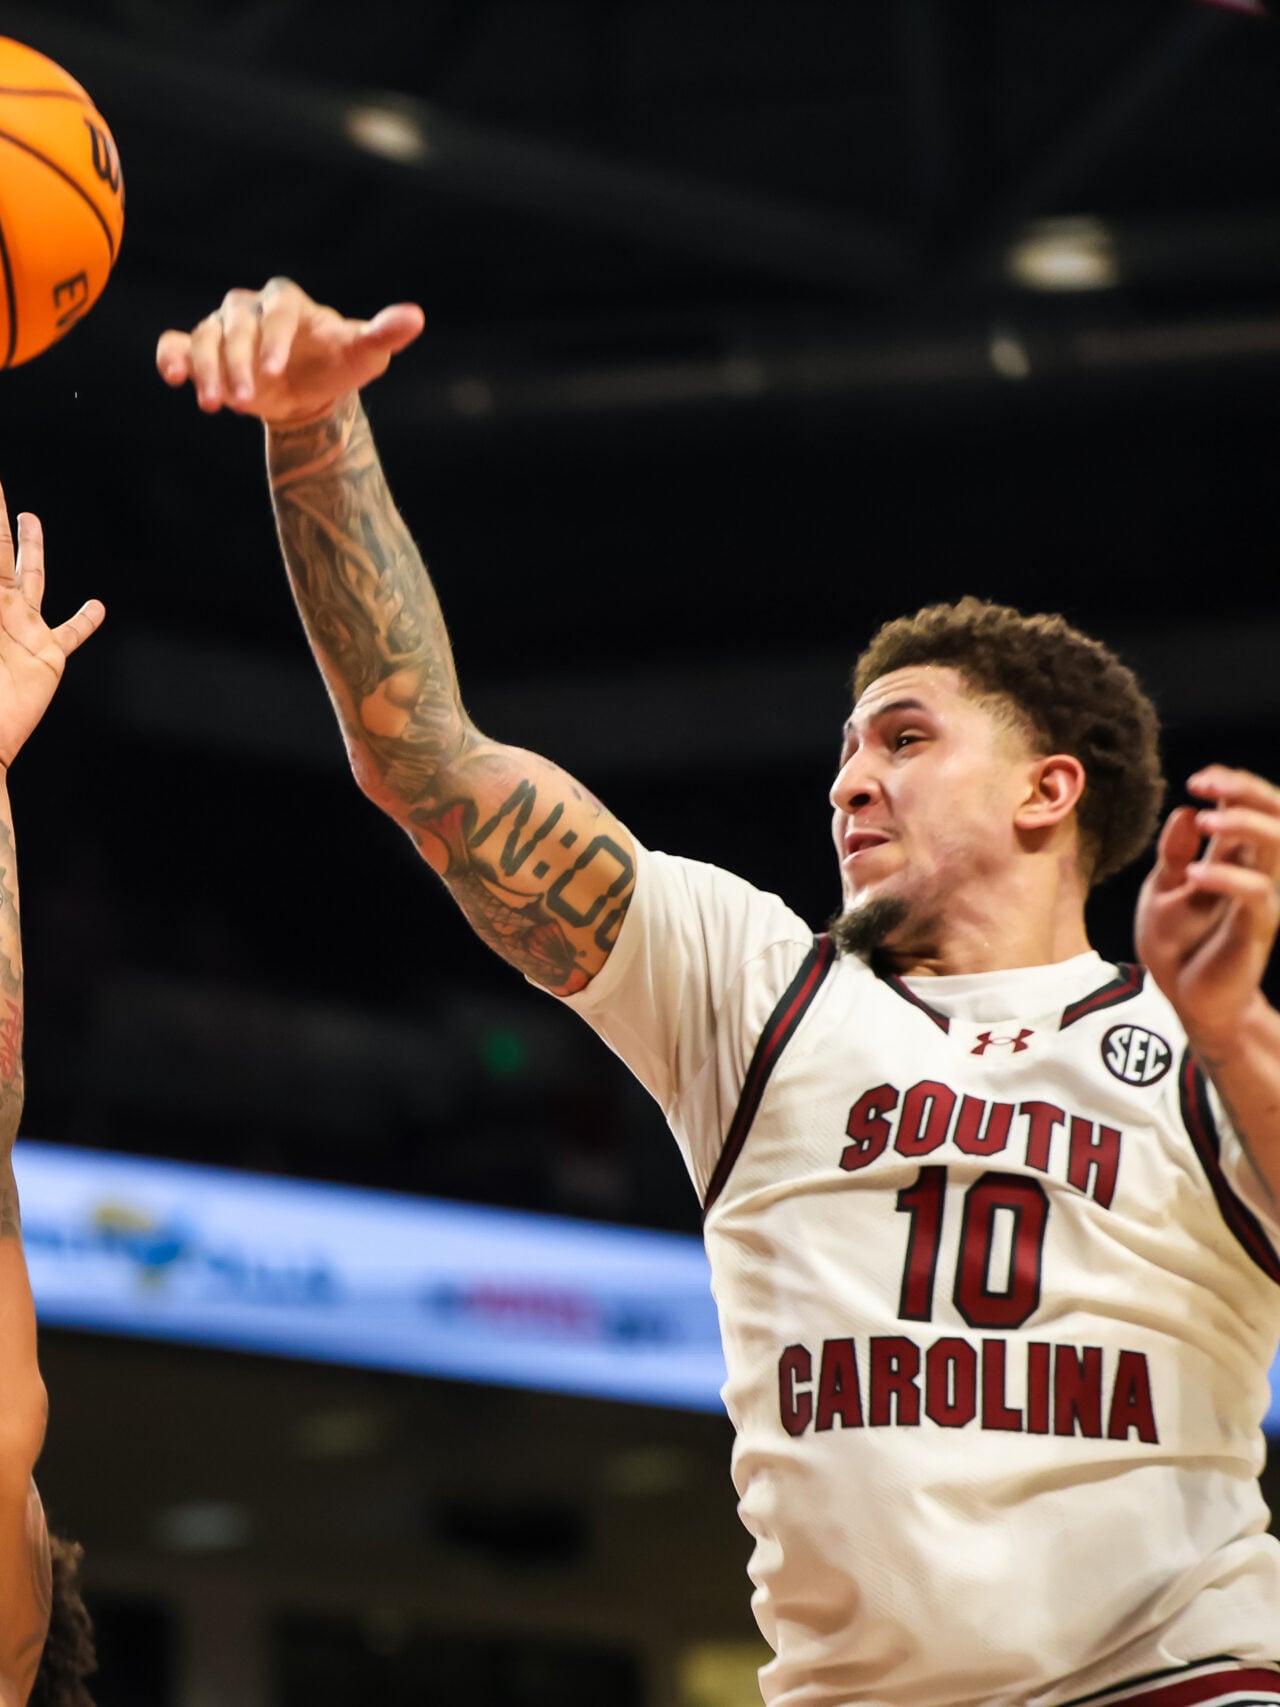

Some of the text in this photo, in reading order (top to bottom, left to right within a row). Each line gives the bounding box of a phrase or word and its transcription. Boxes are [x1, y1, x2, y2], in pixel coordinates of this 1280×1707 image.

[1105, 1026, 1169, 1083] SEC
[839, 1080, 1121, 1210] SOUTH
[895, 1165, 1050, 1329] 10
[778, 1336, 1159, 1444] CAROLINA
